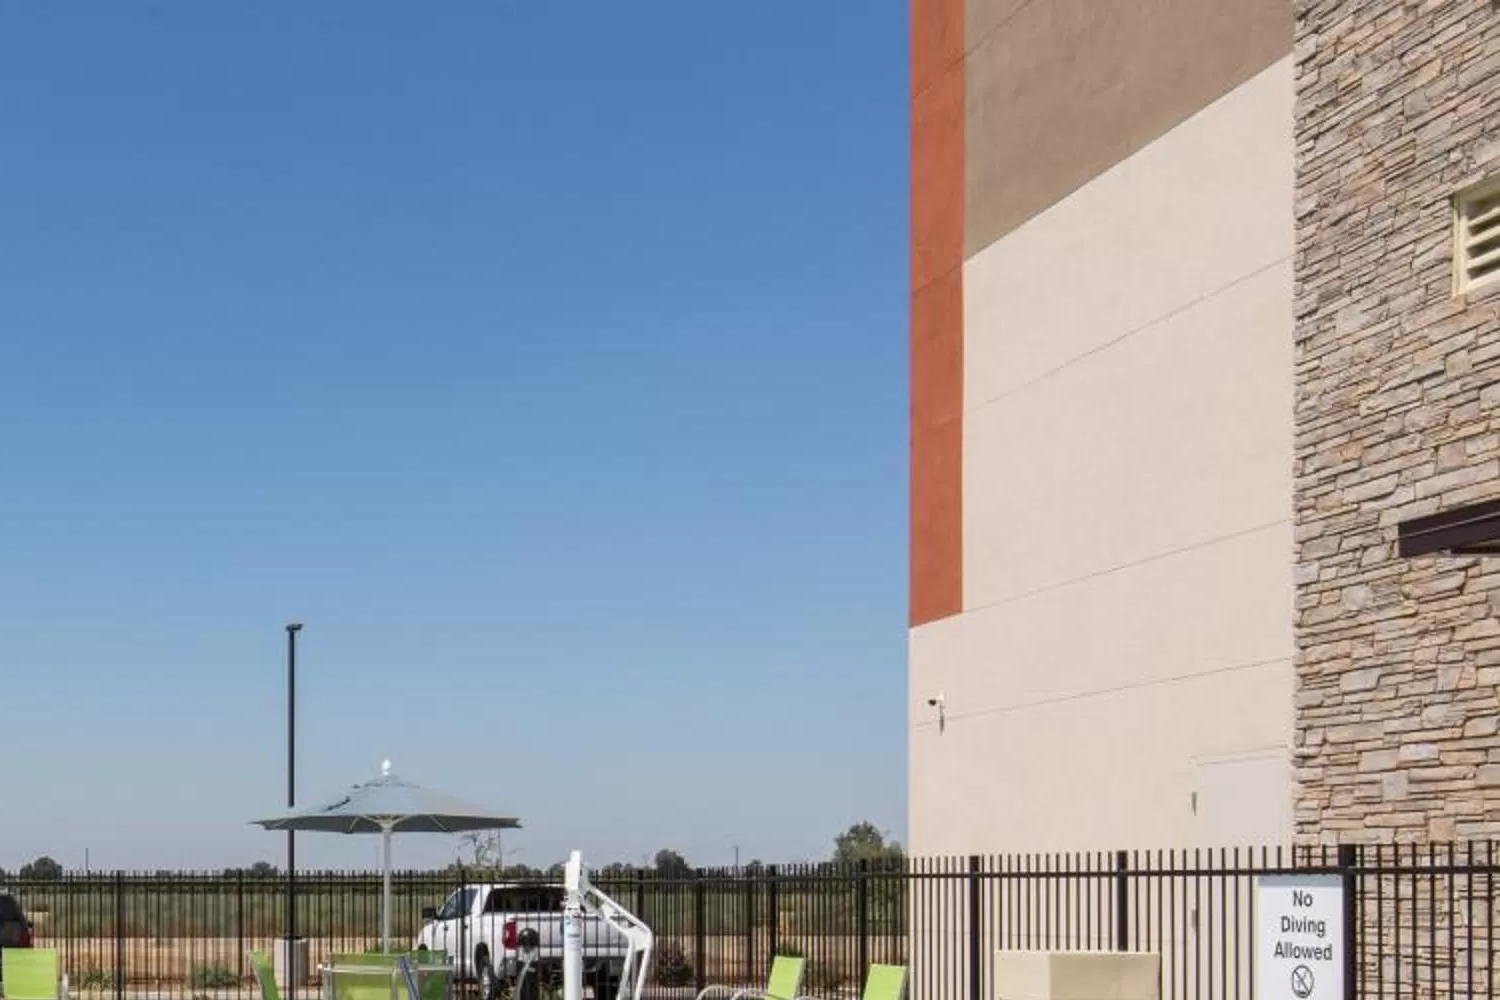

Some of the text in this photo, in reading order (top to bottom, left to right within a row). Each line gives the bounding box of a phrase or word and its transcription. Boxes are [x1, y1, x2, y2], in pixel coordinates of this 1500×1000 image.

[1292, 890, 1313, 908] No
[1280, 915, 1325, 938] Diving
[1273, 941, 1333, 961] Allowed
